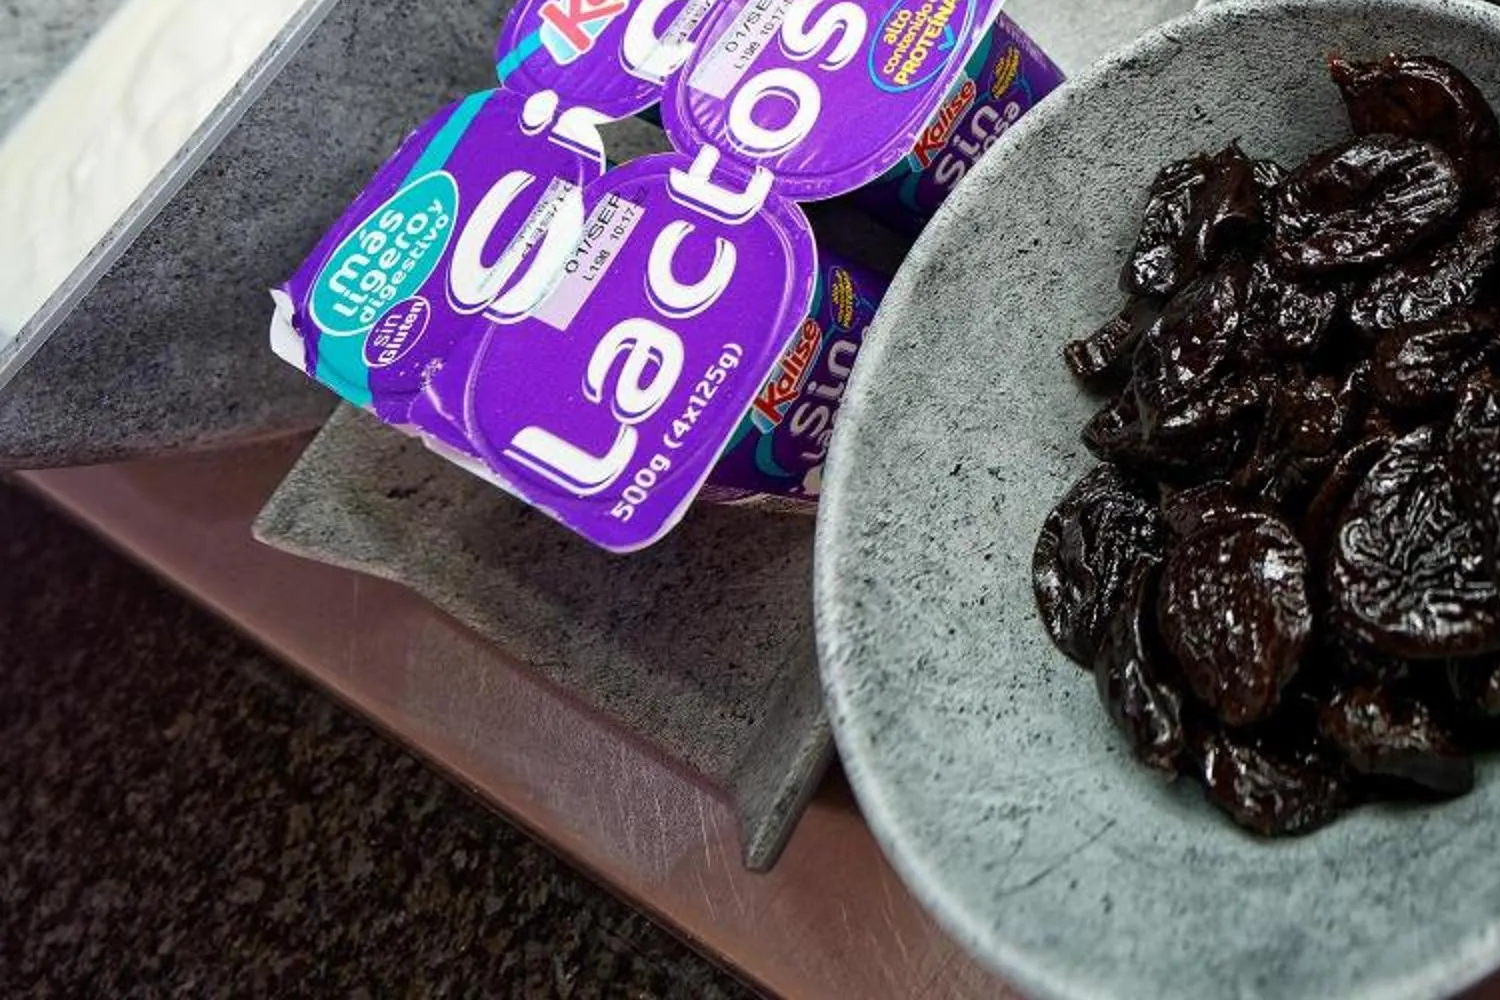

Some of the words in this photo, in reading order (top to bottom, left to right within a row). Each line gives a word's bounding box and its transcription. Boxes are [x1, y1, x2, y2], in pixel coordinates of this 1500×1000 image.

[884, 9, 912, 46] alto
[884, 3, 933, 75] contenido
[913, 80, 976, 169] Kalise
[934, 105, 1000, 186] Sin
[329, 209, 405, 294] más
[333, 213, 429, 317] ligero
[359, 214, 449, 323] digestivo
[565, 191, 622, 275] 01/SEP
[374, 314, 403, 348] sin
[378, 301, 426, 364] Gluten
[753, 318, 821, 424] Kalise
[790, 338, 858, 438] Sin
[610, 453, 672, 523] 500g
[663, 343, 744, 449] (4x125g)
